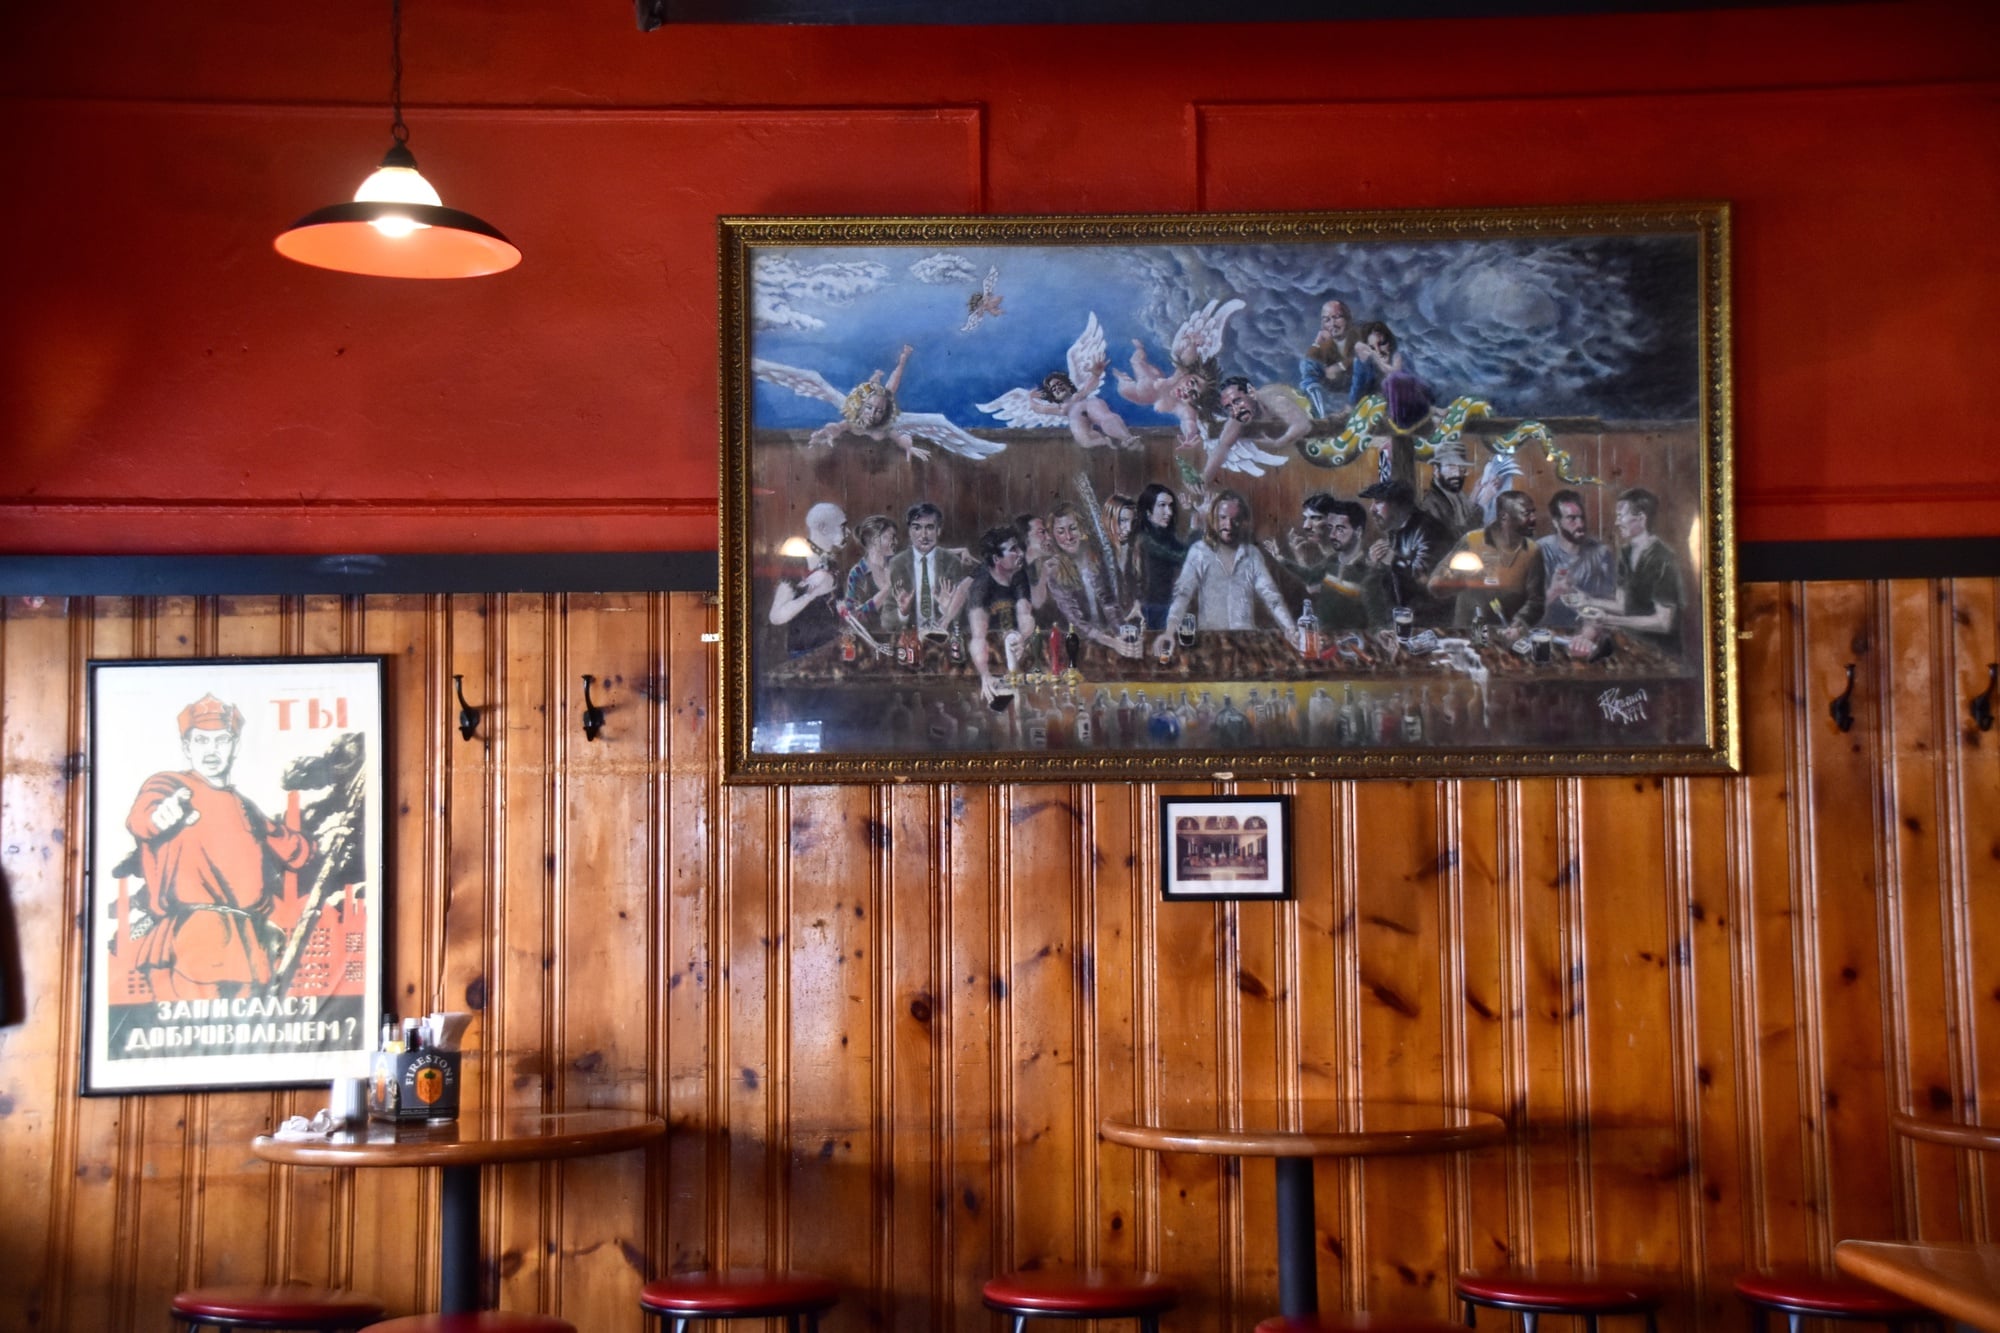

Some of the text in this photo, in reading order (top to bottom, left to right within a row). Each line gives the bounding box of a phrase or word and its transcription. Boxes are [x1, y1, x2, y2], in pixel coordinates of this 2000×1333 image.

[269, 697, 348, 731] ТЫ
[157, 996, 317, 1020] ЗАПИСАЛСЯ
[405, 1054, 453, 1085] FIRESTONE
